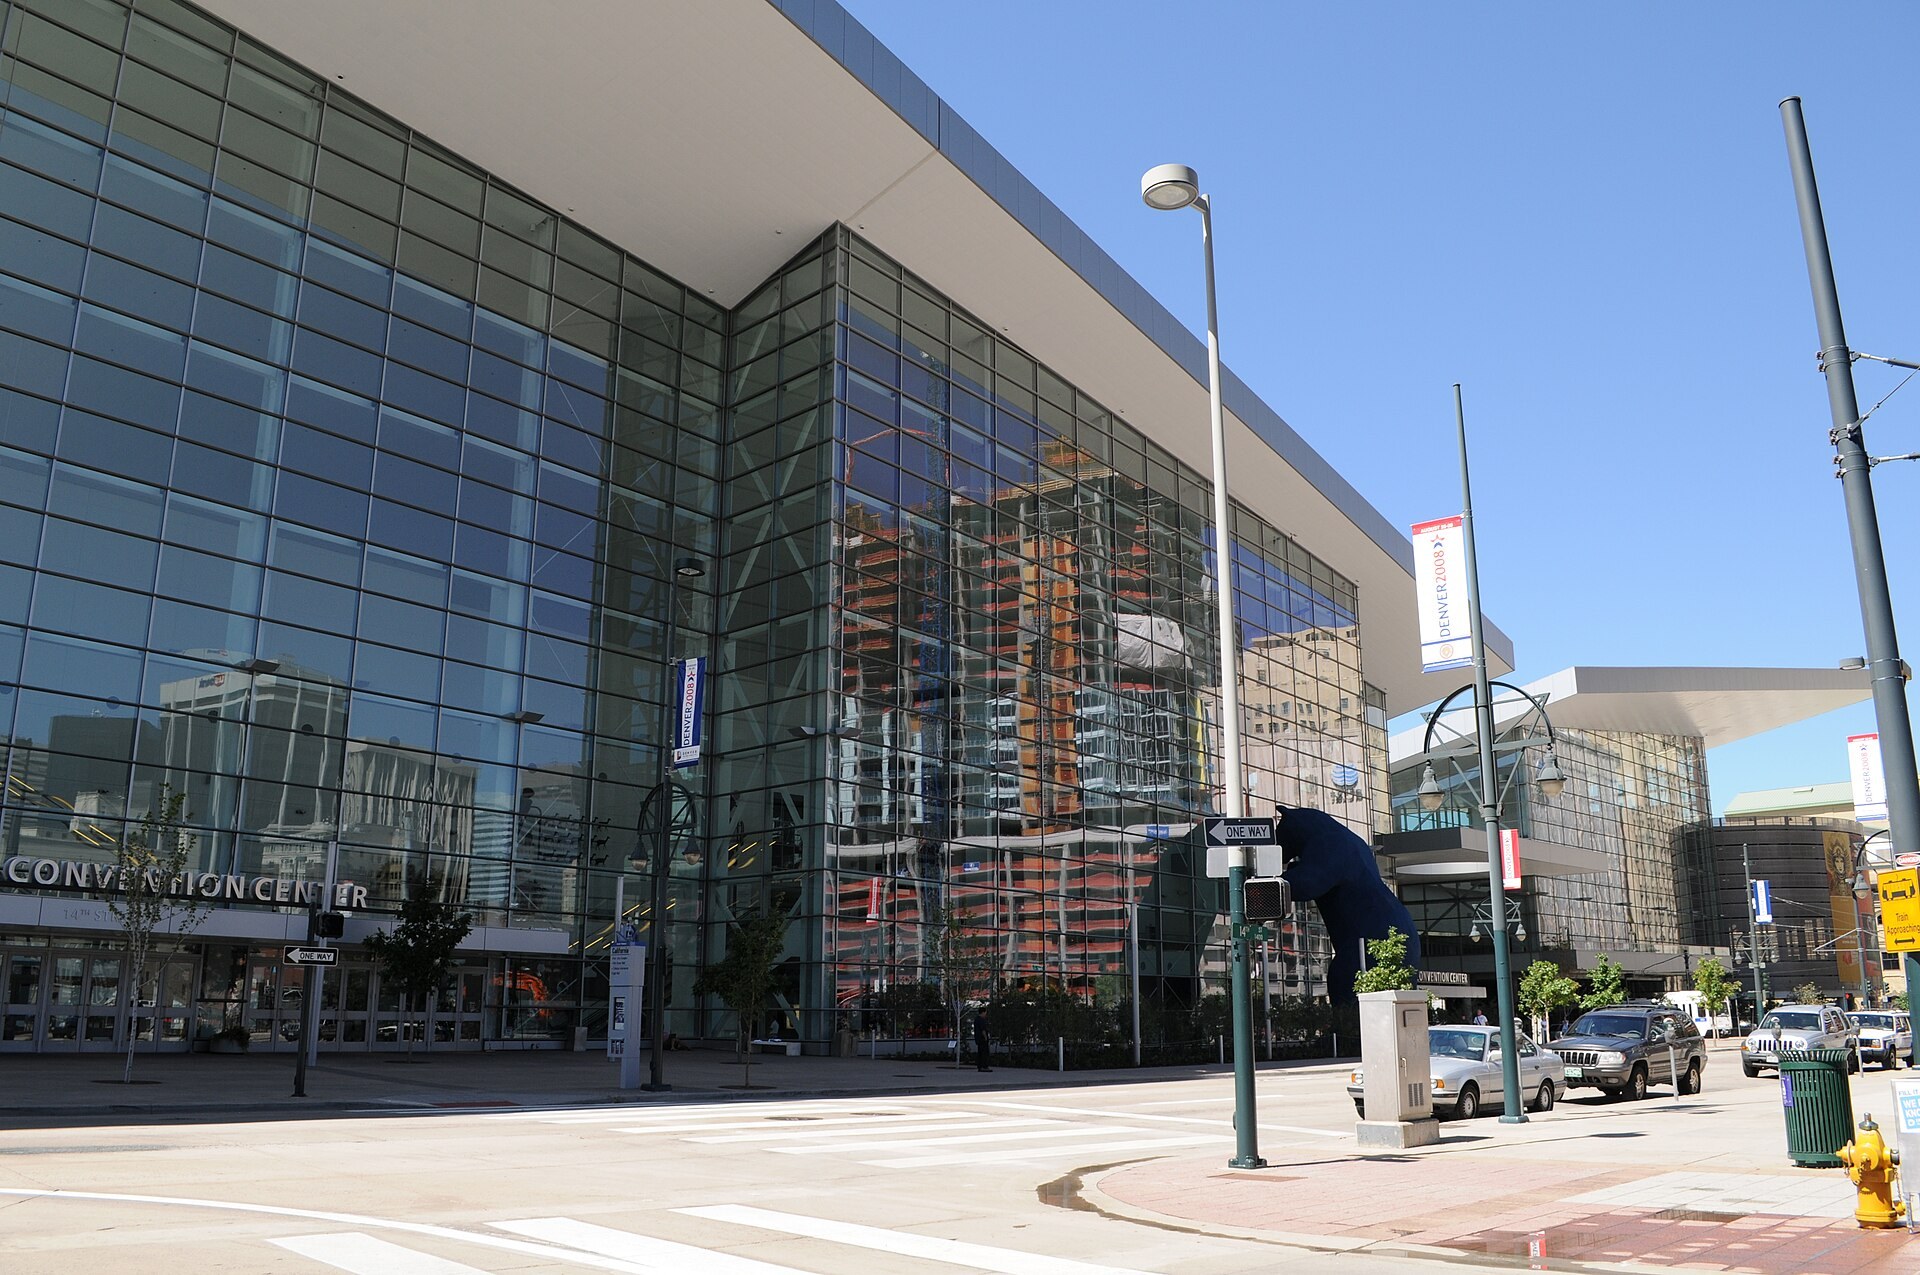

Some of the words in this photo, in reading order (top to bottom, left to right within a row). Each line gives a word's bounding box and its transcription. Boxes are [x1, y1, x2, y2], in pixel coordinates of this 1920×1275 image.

[1433, 550, 1451, 637] DENVER2008
[683, 683, 695, 745] DENVER2008
[1226, 826, 1245, 837] ONE
[1248, 826, 1267, 837] WAY
[255, 877, 368, 908] CENER
[1896, 912, 1909, 921] Train
[1887, 923, 1920, 934] Approaching
[300, 952, 314, 960] ONE
[1418, 971, 1450, 983] ONVENTION
